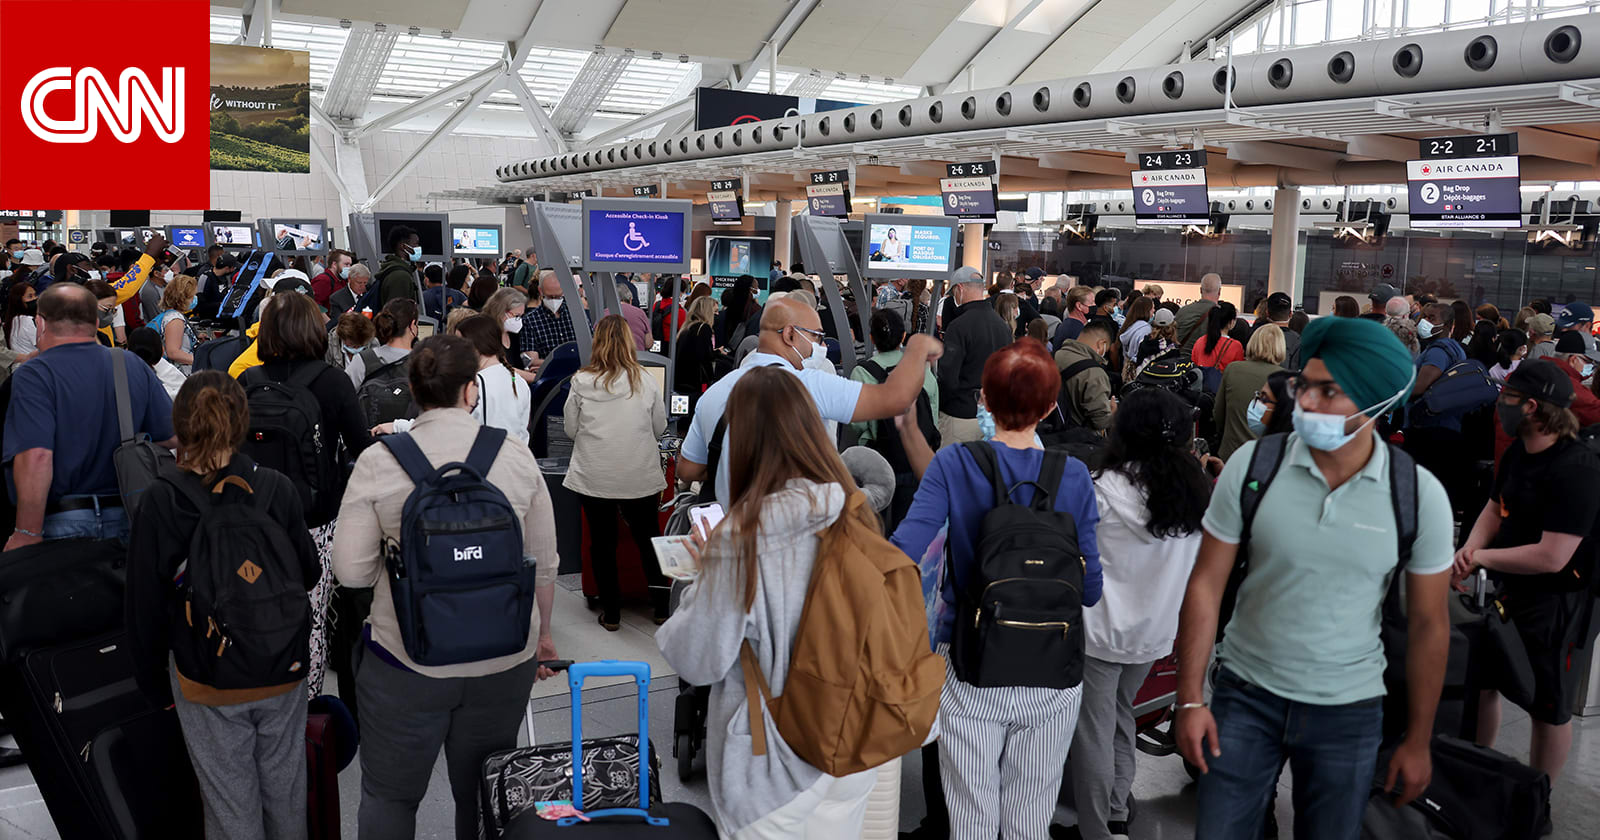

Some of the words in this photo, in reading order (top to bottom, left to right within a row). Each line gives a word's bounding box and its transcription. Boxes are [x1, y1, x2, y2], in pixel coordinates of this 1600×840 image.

[225, 100, 266, 109] WITHOUT
[1430, 140, 1454, 154] 2-2
[1476, 138, 1496, 152] 2-1
[1145, 155, 1162, 167] 2-4
[1175, 153, 1192, 165] 2-3
[951, 165, 963, 175] 2-6
[971, 164, 983, 174] 2-5
[1435, 165, 1454, 173] AIR
[1456, 163, 1504, 173] CANADA
[829, 172, 838, 182] 2-7
[1442, 185, 1455, 193] Bag
[1455, 185, 1470, 193] Drop
[453, 546, 483, 561] bird
